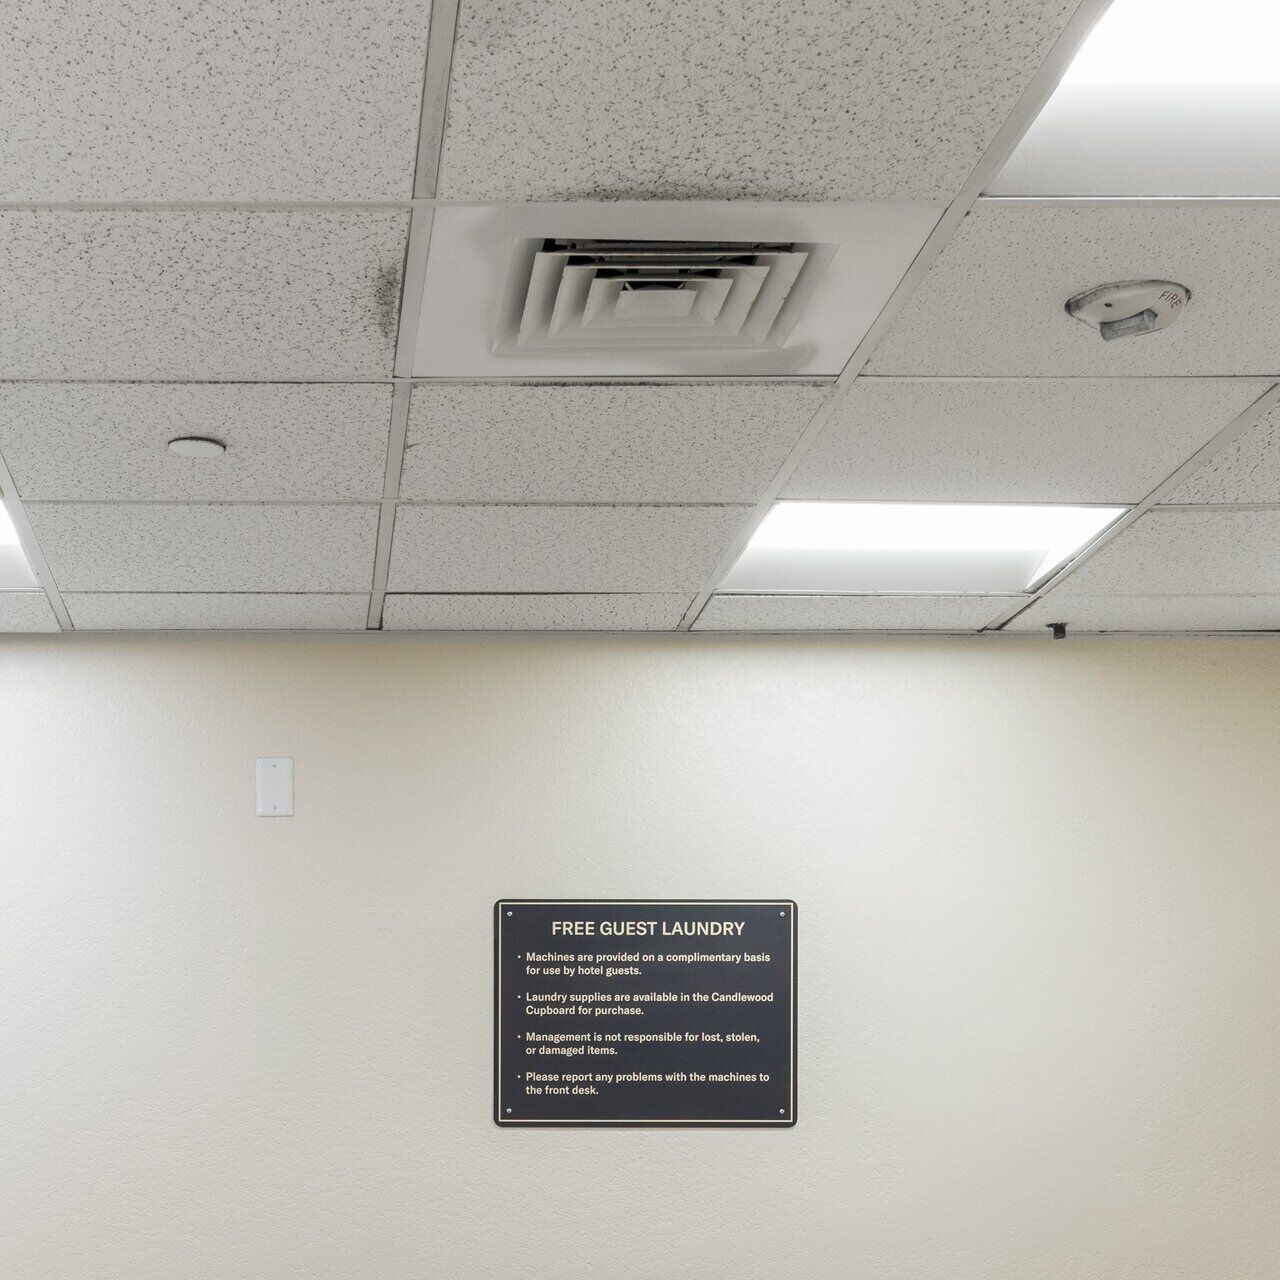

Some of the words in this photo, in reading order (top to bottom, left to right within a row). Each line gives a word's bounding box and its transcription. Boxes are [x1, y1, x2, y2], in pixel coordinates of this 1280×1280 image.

[1158, 290, 1182, 309] FIRE
[552, 921, 595, 935] FREE
[599, 921, 658, 936] GUEST
[662, 921, 746, 936] LAUNDRY
[526, 952, 575, 962] Machines
[577, 954, 594, 962] are
[596, 952, 640, 964] provided
[642, 954, 655, 962] on
[657, 954, 664, 962] a
[666, 952, 742, 964] complimentary
[744, 952, 771, 962] basis
[526, 965, 541, 975] for
[543, 967, 561, 975] use
[563, 965, 576, 977] by
[578, 965, 603, 975] hotel
[605, 966, 642, 977] guests.
[526, 992, 568, 1004] Laundry
[569, 992, 612, 1004] supplies
[614, 994, 631, 1002] are
[632, 992, 678, 1002] available
[680, 992, 690, 1002] in
[692, 992, 709, 1002] the
[711, 992, 774, 1002] Candlewood
[525, 1005, 575, 1017] Cupboard
[578, 1005, 593, 1015] for
[595, 1005, 644, 1017] purchase.
[526, 1032, 591, 1044] Management
[593, 1032, 602, 1042] is
[605, 1033, 622, 1042] not
[624, 1032, 683, 1044] responsible
[684, 1032, 700, 1042] for
[701, 1032, 723, 1043] lost,
[725, 1032, 760, 1043] stolen,
[525, 1047, 537, 1055] or
[538, 1045, 584, 1057] damaged
[587, 1045, 618, 1055] items.
[526, 1072, 559, 1081] Please
[562, 1073, 593, 1083] report
[595, 1074, 614, 1084] any
[616, 1072, 663, 1083] problems
[665, 1072, 687, 1082] with
[689, 1072, 706, 1082] the
[708, 1072, 757, 1082] machines
[759, 1073, 770, 1082] to
[525, 1085, 543, 1095] the
[544, 1085, 570, 1095] front
[572, 1085, 599, 1095] desk.
